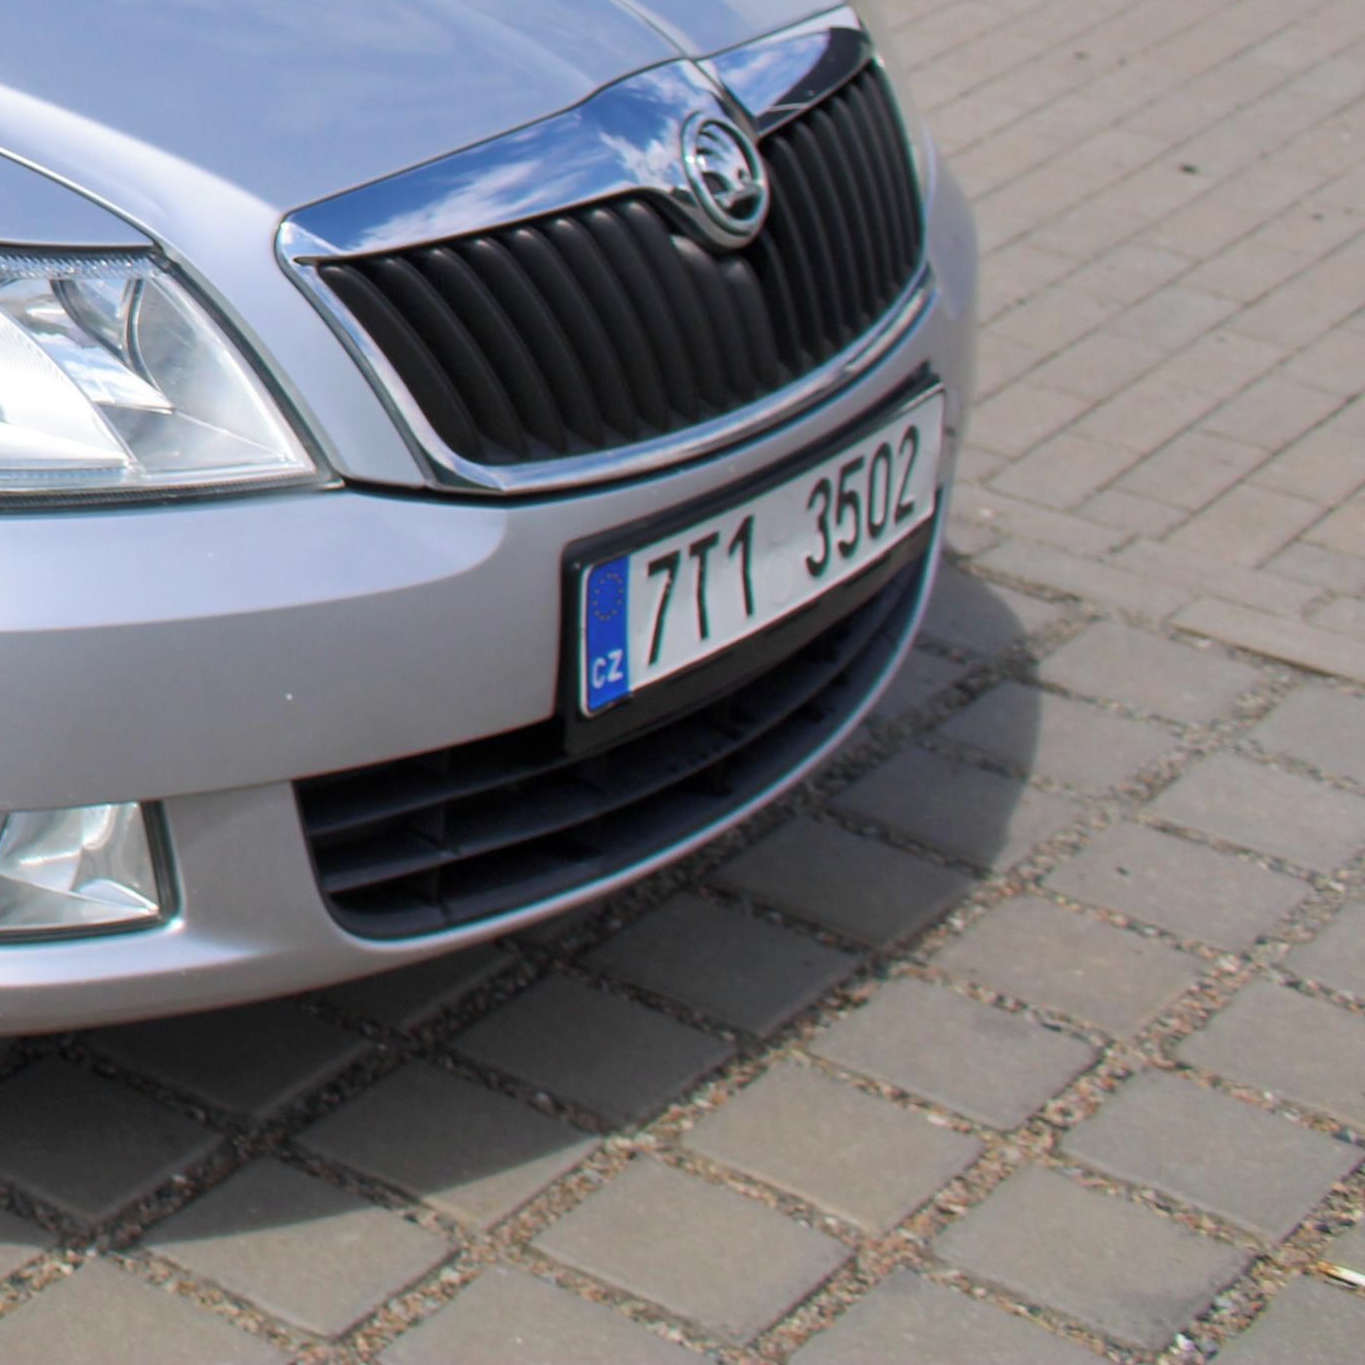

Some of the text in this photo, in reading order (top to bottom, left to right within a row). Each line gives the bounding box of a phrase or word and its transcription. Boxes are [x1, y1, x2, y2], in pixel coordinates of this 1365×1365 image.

[646, 425, 921, 667] 7T1 3502
[591, 648, 624, 689] CZ
